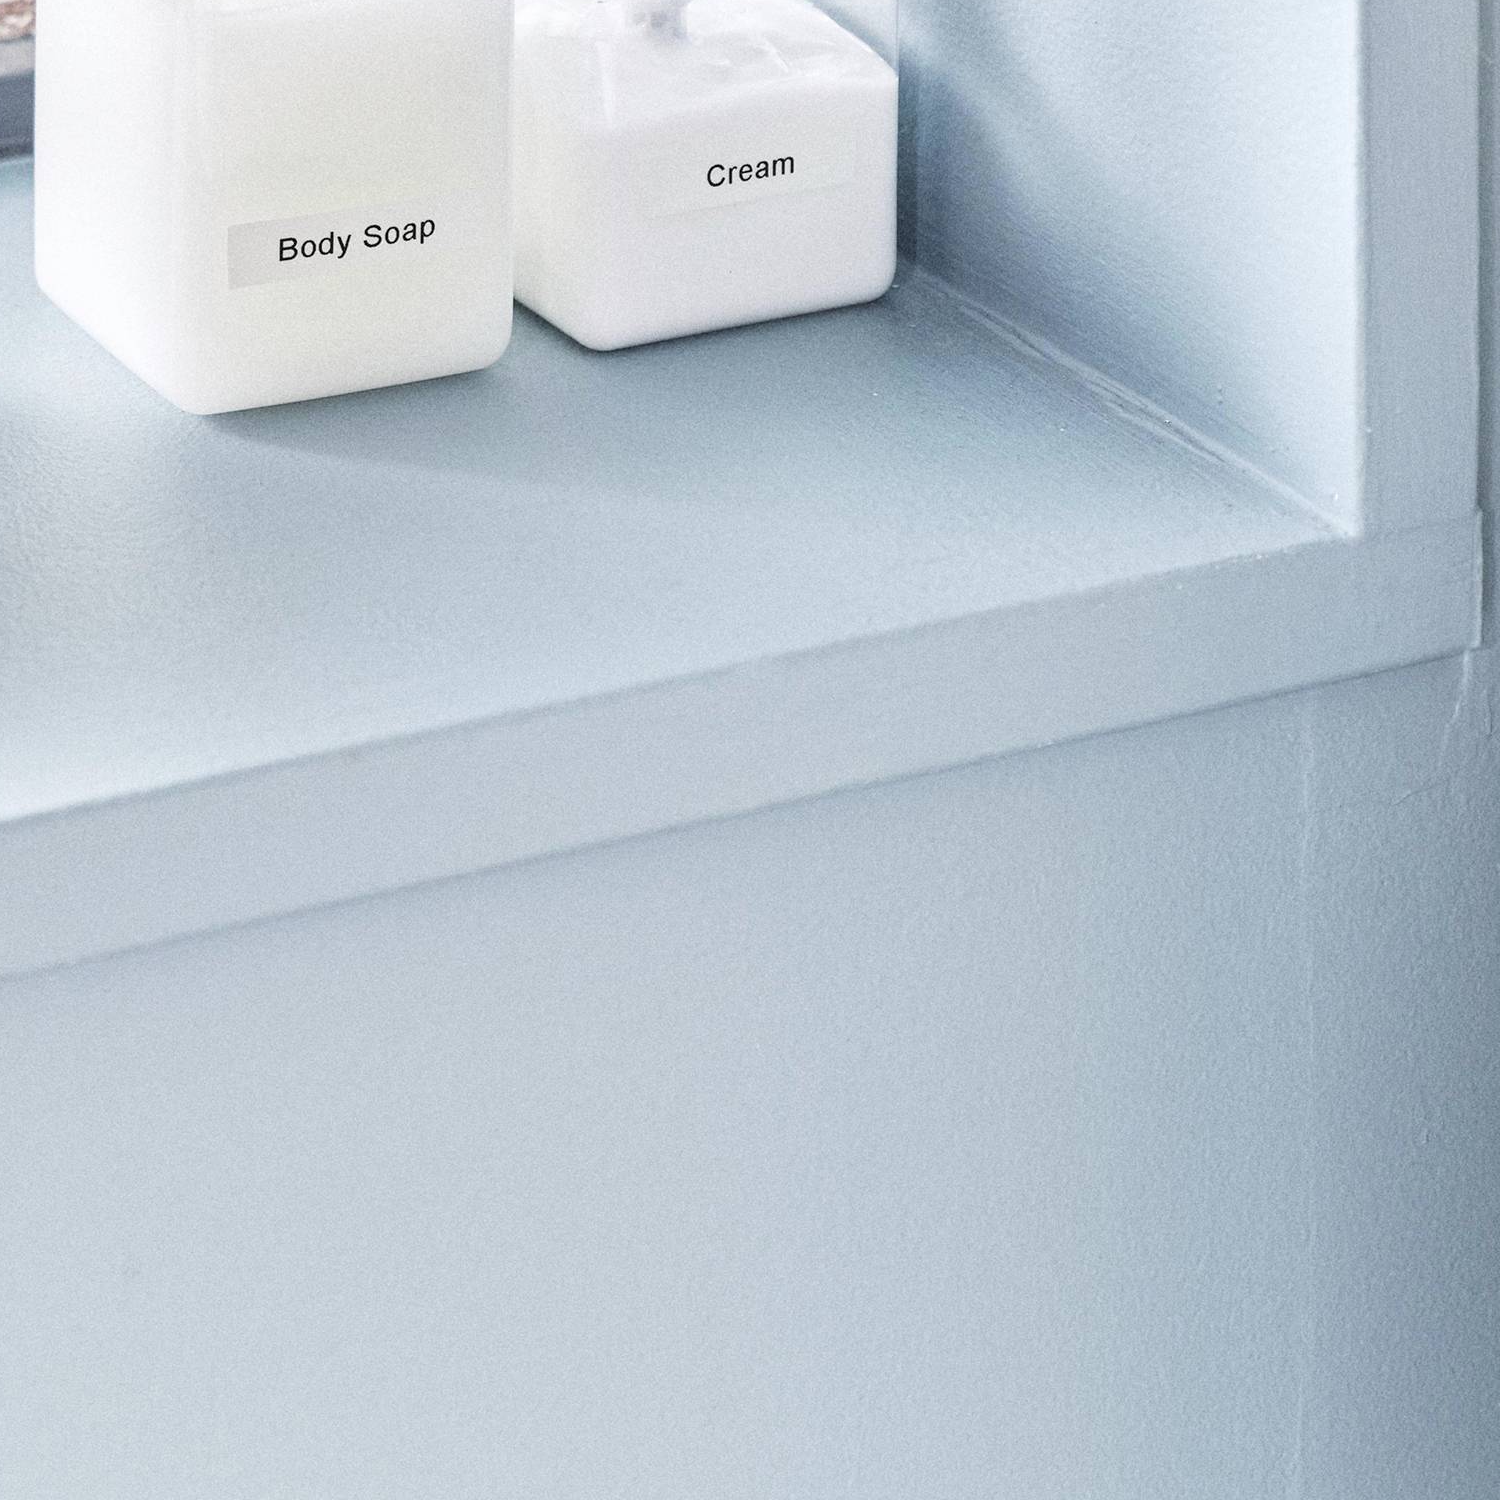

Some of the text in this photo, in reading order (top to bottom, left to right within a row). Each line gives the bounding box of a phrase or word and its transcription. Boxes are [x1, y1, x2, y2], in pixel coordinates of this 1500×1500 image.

[706, 155, 795, 188] Cream
[278, 218, 436, 262] Body Soap
